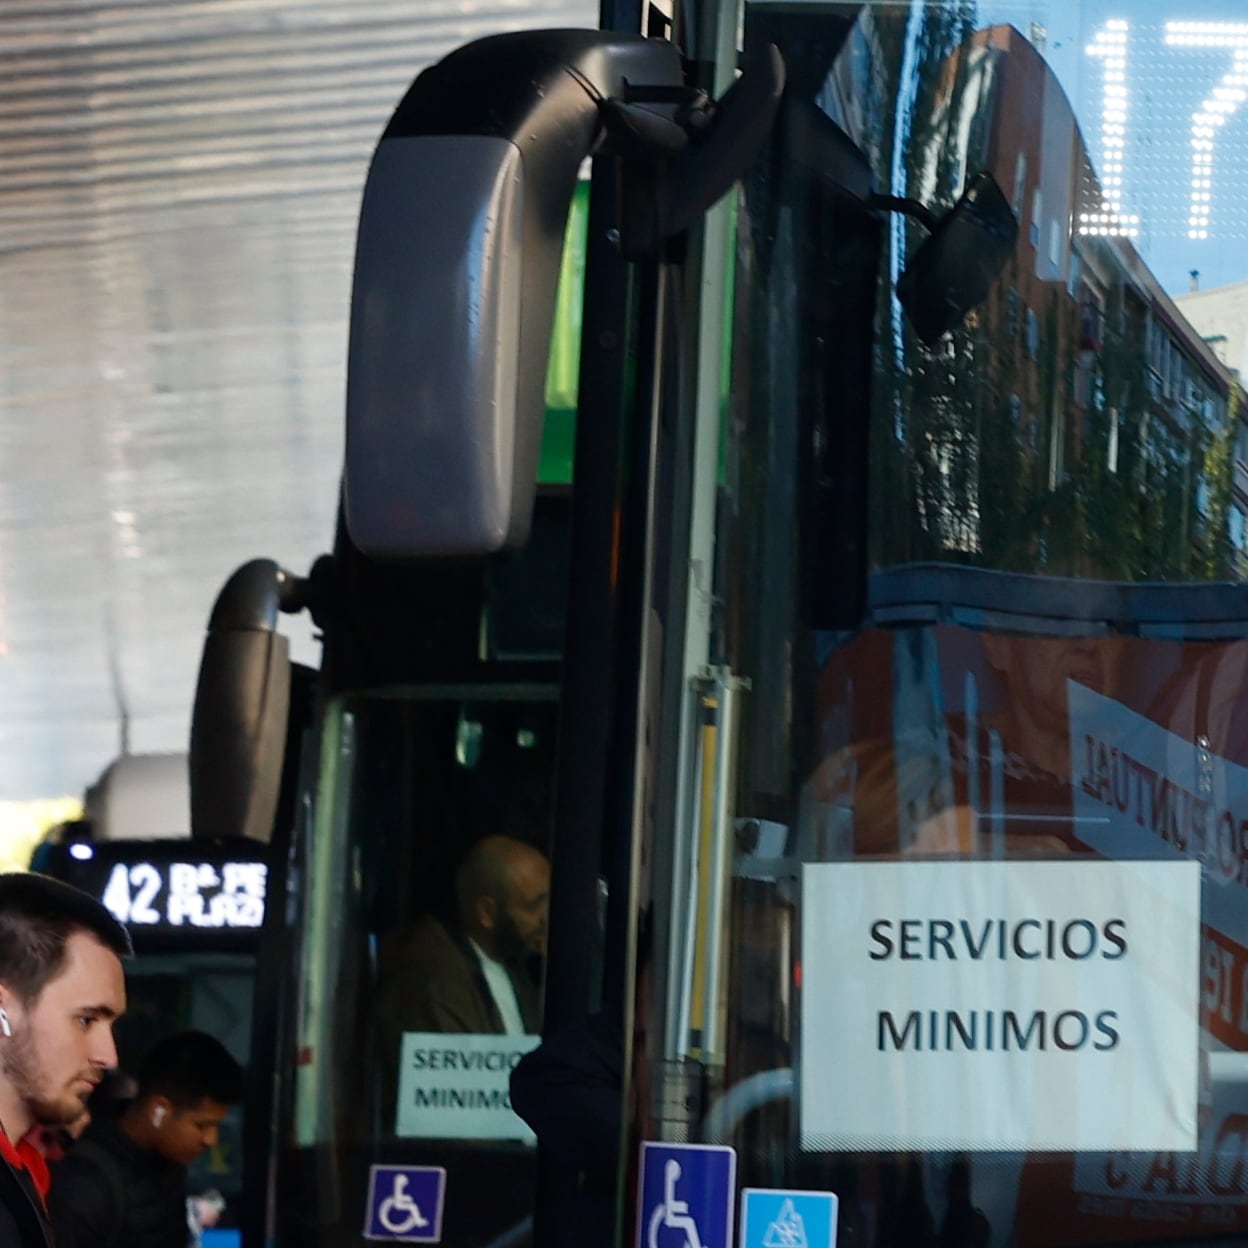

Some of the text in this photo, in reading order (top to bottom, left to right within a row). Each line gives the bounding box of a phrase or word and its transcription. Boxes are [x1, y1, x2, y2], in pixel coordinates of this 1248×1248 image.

[103, 862, 163, 925] 42
[868, 918, 1128, 961] SERVICIOS
[877, 1009, 1120, 1052] MINIMOS
